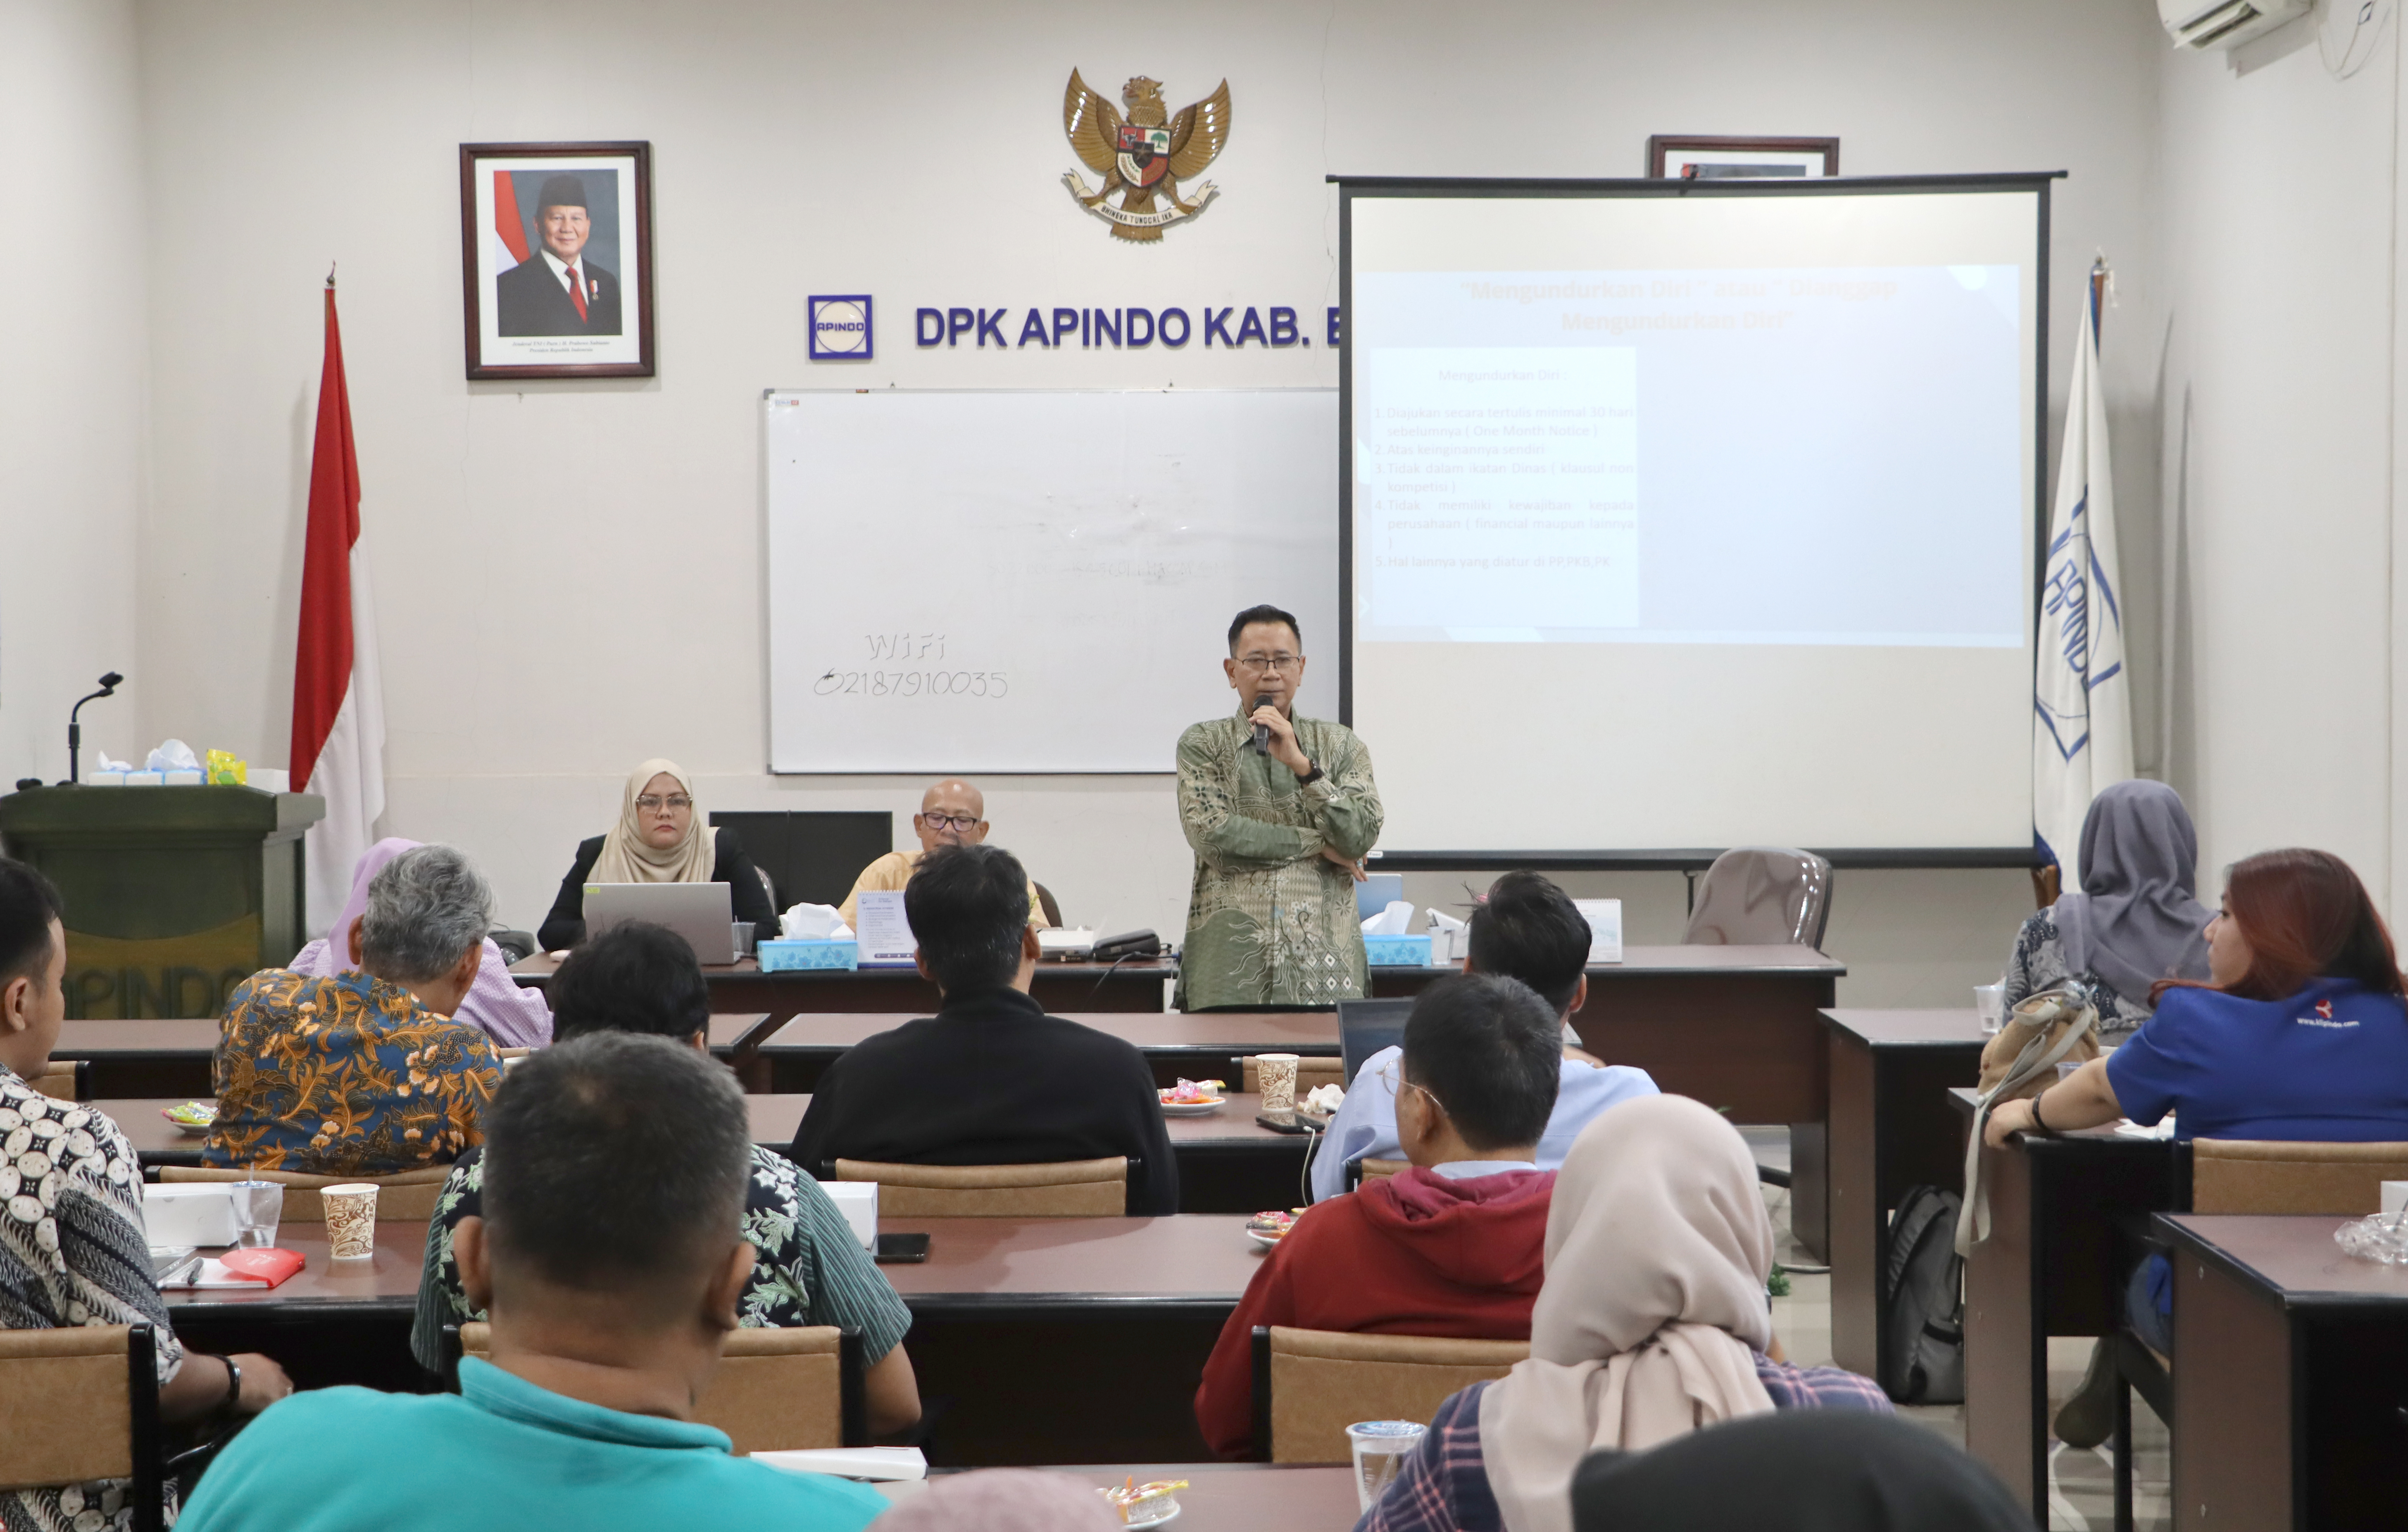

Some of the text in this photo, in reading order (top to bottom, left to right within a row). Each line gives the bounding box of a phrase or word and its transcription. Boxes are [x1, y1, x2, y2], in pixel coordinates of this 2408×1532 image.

[1130, 215, 1160, 224] TUNGGAL
[1162, 211, 1173, 221] IKA
[1652, 280, 1690, 298] Diri
[1713, 281, 1766, 297] atau
[1789, 278, 1897, 302] Dianggap
[817, 323, 864, 331] APINDO
[917, 307, 1008, 346] DPK
[1018, 307, 1191, 346] APINDO
[1204, 306, 1309, 346] KAB.
[1561, 311, 1735, 335] Mengundurkan
[1439, 370, 1534, 382] Mengundurkan
[1538, 369, 1560, 380] Diri
[1387, 407, 1441, 421] Diajukan
[1445, 410, 1484, 418] secara
[1487, 407, 1532, 418] tertulis
[1536, 407, 1587, 418] minimal
[1590, 407, 1606, 418] 30
[1609, 407, 1634, 418] hari
[1387, 425, 1462, 440] sebelumnya
[1473, 426, 1500, 437] One
[1503, 425, 1545, 437] Month
[1549, 425, 1589, 437] Notice
[1387, 444, 1413, 455] Atas
[1418, 444, 1499, 458] keinginannya
[1502, 444, 1545, 455] sendiri
[1388, 463, 1420, 474] Tidak
[1425, 463, 1464, 474] dalam
[1469, 463, 1506, 474] ikatan
[1512, 463, 1547, 474] Dinas
[1561, 463, 1605, 474] klausul
[1609, 466, 1634, 474] non
[1388, 481, 1448, 494] kompetisi
[1388, 500, 1421, 511] Tidak
[1438, 500, 1491, 511] memiliki
[1509, 500, 1572, 513] kewajiban
[1589, 500, 1634, 513] kepada
[1388, 518, 1461, 532] perusahaan
[1475, 518, 1528, 529] financial
[1533, 521, 1585, 532] maupun
[1589, 518, 1634, 532] lainnya
[1388, 556, 1409, 567] Hal
[1412, 556, 1456, 570] lainnya
[1460, 558, 1490, 570] yang
[1492, 556, 1530, 567] diatur
[1533, 556, 1545, 567] di
[814, 668, 1008, 698] 02187910035
[63, 969, 249, 1019] PINDO
